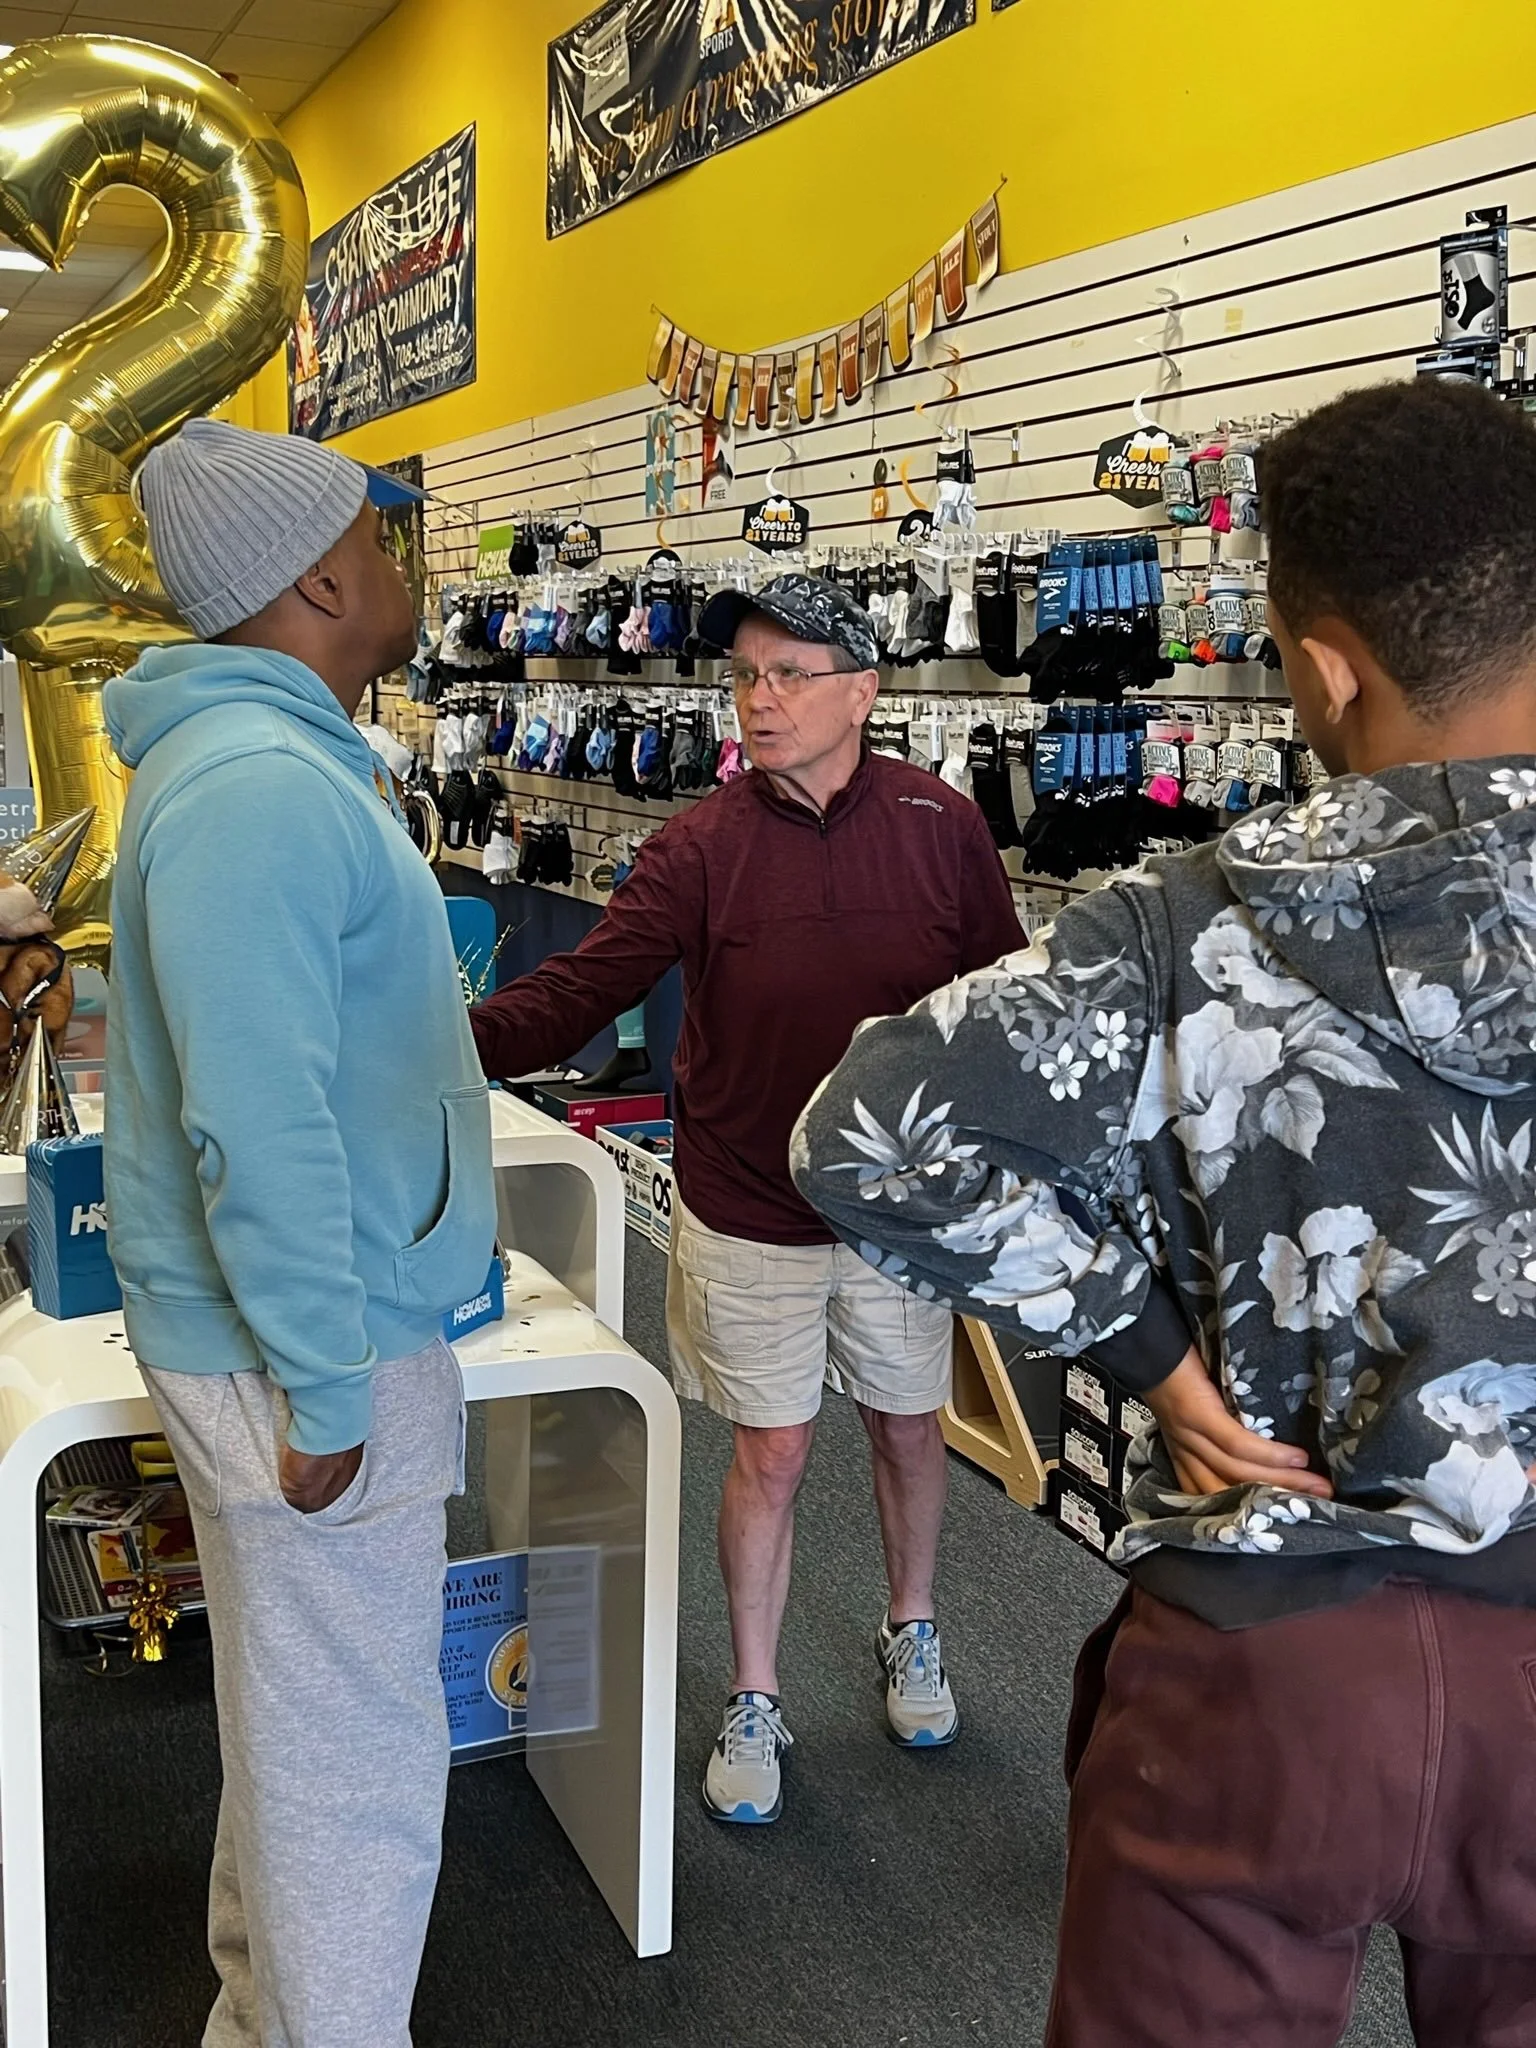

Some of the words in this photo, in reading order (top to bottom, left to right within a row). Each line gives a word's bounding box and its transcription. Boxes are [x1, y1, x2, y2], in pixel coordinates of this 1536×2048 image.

[699, 27, 734, 60] SPORTS
[943, 250, 961, 275] ALE
[1106, 454, 1161, 475] Cheers
[1098, 472, 1122, 491] 21
[749, 514, 786, 532] Cheers
[787, 521, 802, 532] TO
[745, 530, 761, 543] 21
[761, 530, 803, 544] YEARS
[569, 547, 600, 561] YEARS
[1039, 577, 1069, 588] BROOKS
[1214, 600, 1244, 612] ACTIVE
[1036, 742, 1063, 753] BROOKS
[470, 1571, 503, 1589] ARE
[440, 1652, 477, 1664] VENING
